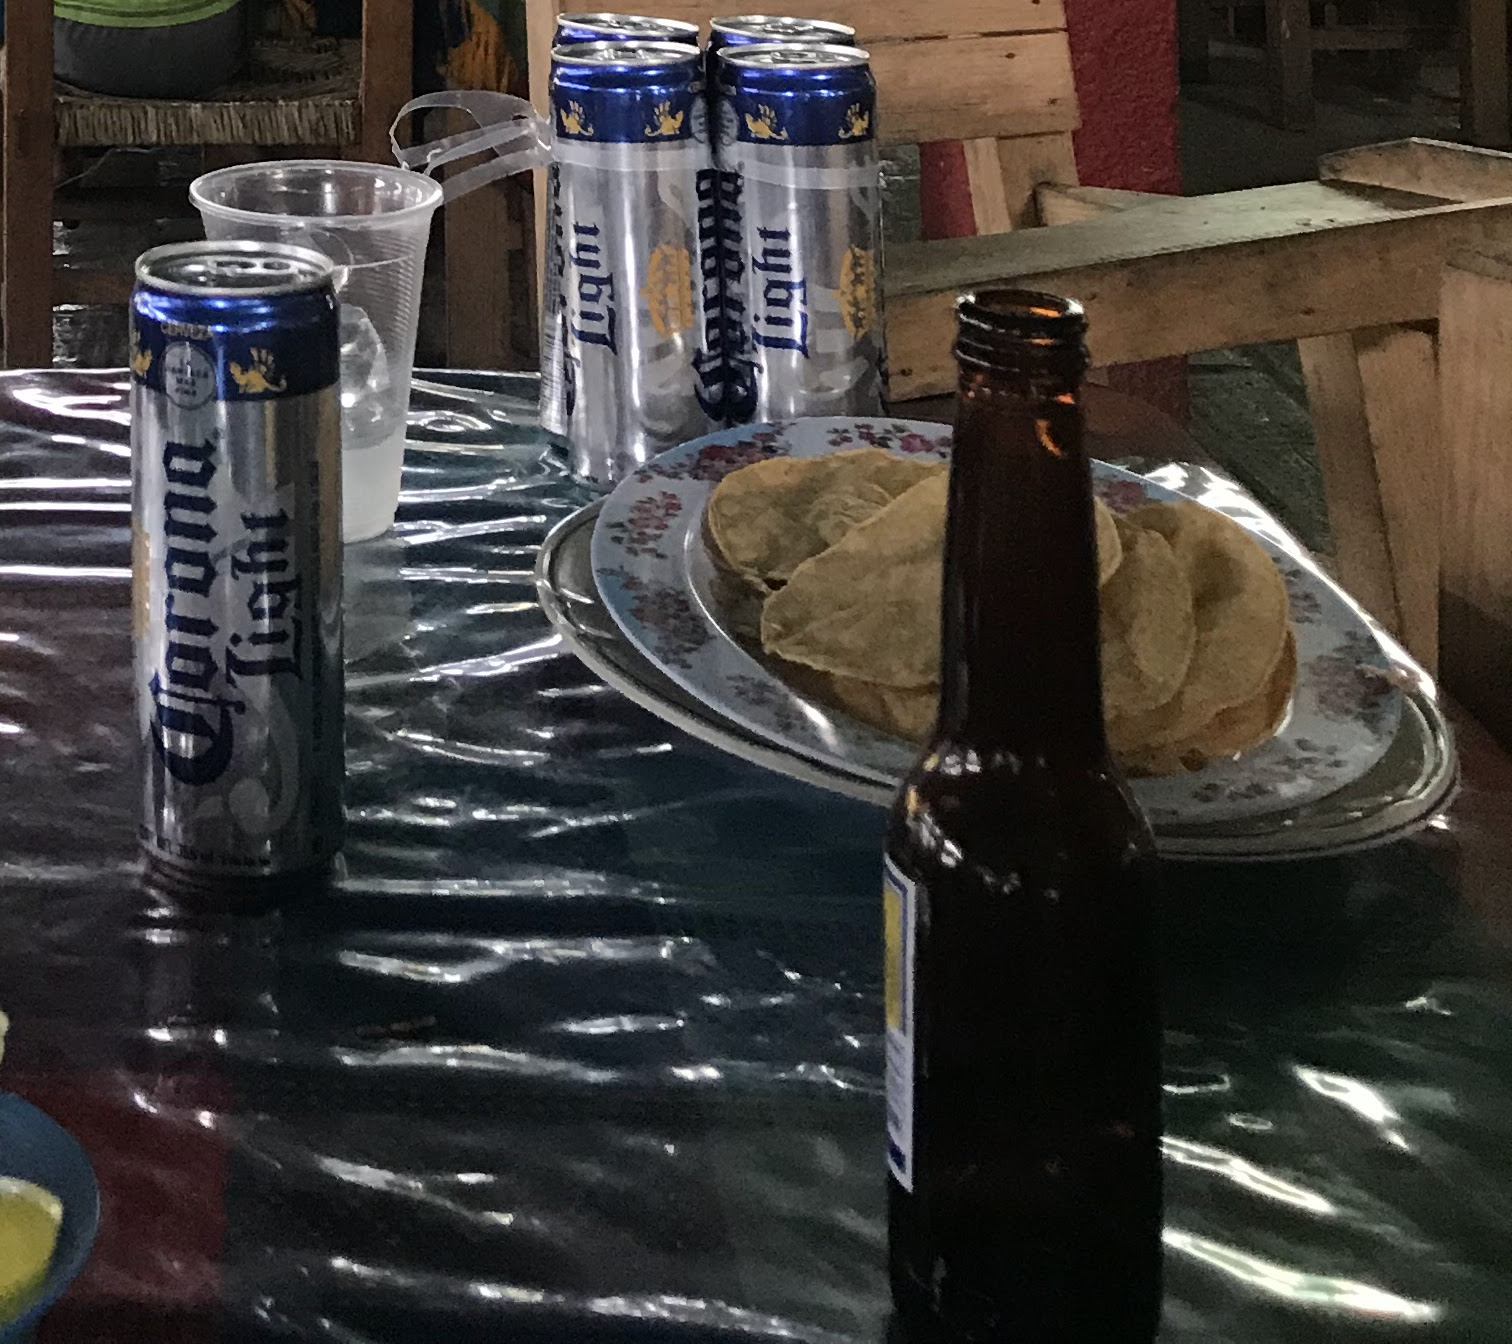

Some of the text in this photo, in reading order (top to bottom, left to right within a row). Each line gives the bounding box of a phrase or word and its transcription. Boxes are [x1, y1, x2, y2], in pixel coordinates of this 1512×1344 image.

[568, 221, 617, 357] Light
[751, 225, 809, 360] Light
[148, 438, 246, 786] Corona
[221, 508, 302, 689] Light
